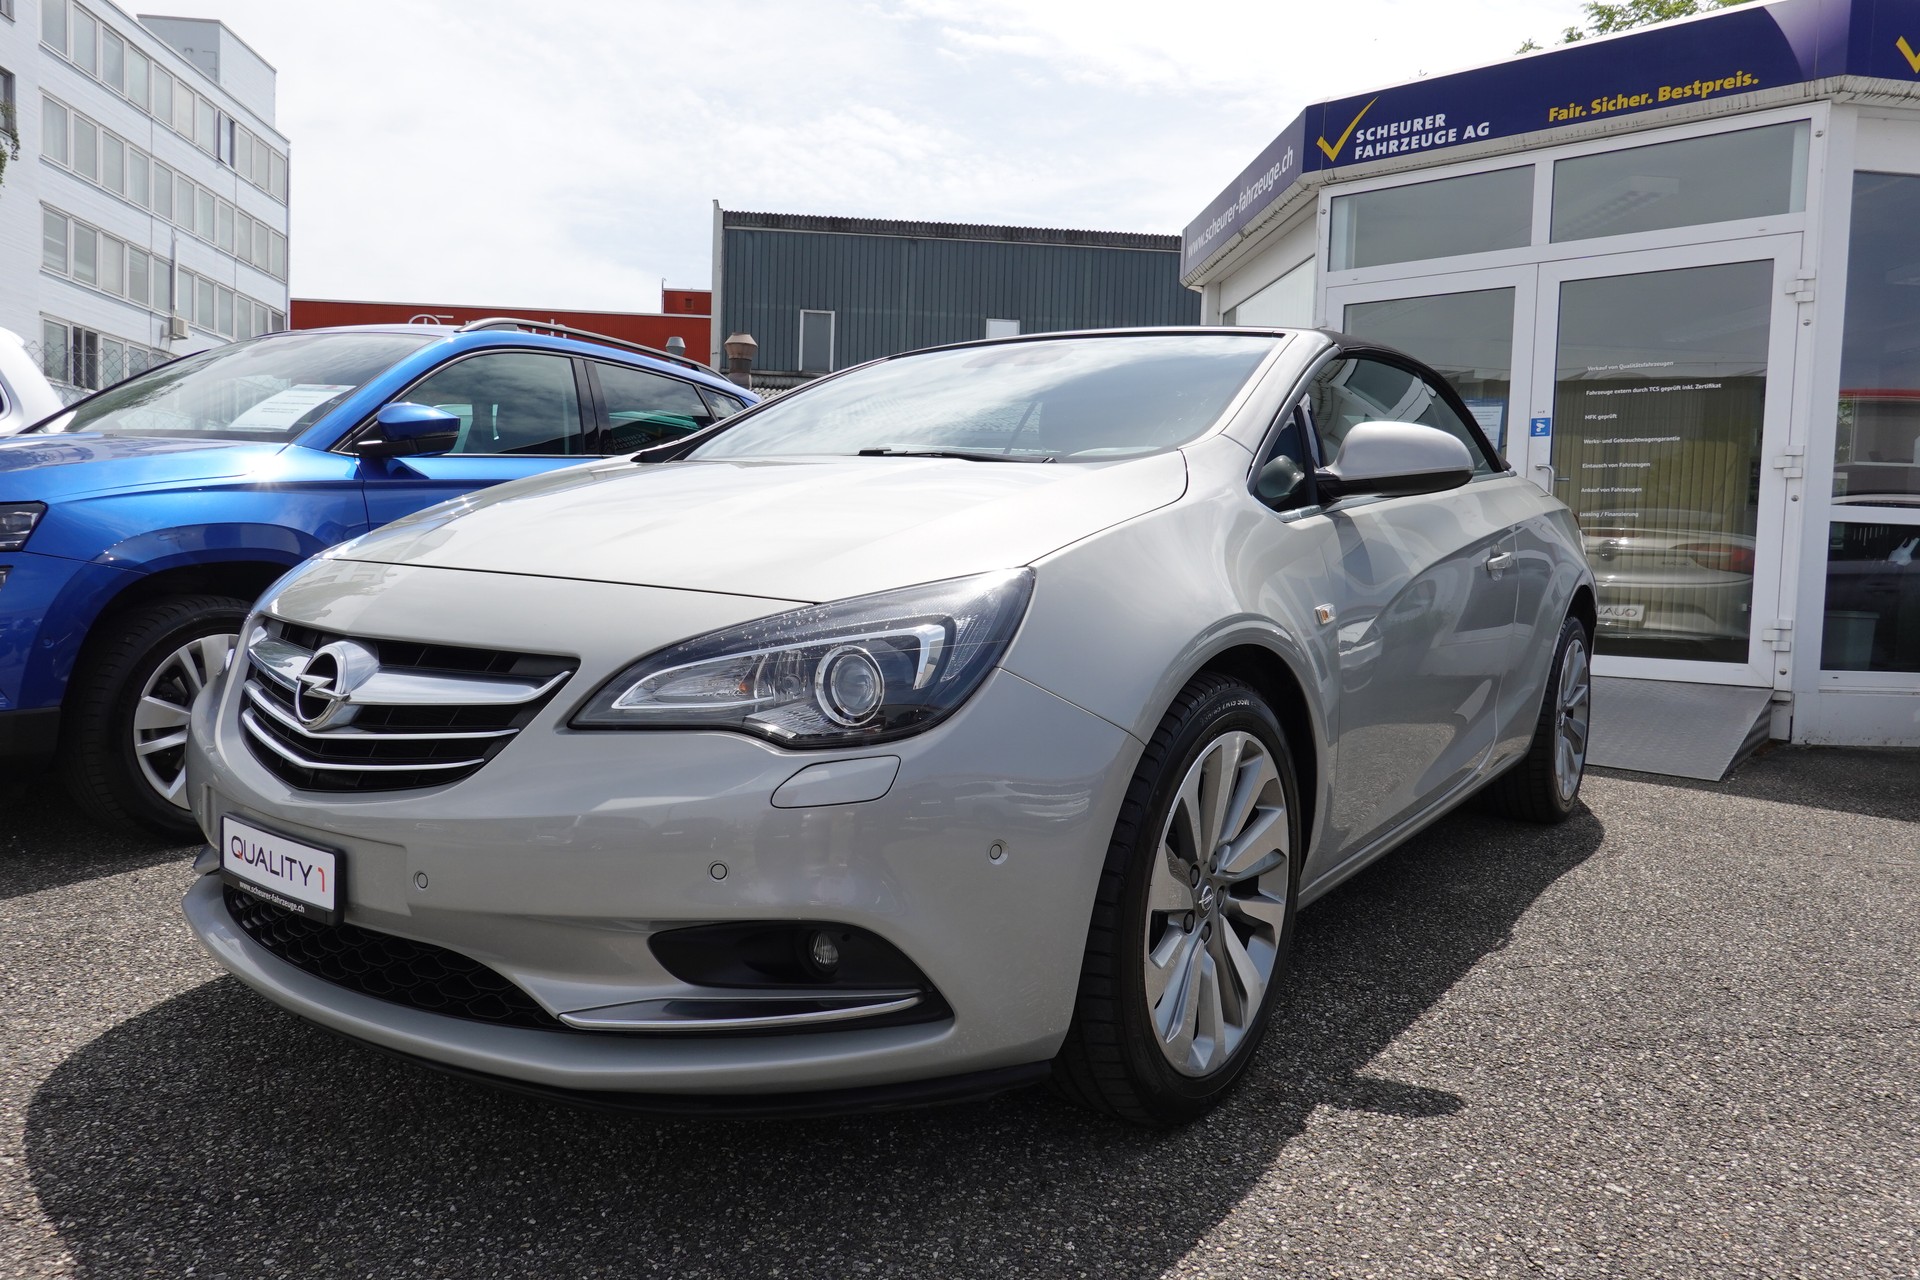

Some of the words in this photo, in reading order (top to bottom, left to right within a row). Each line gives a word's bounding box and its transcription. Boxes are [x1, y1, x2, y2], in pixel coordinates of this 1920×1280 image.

[1548, 102, 1587, 122] Fair.
[1590, 93, 1653, 115] Sicher.
[1657, 70, 1759, 102] Bestpreis.
[1354, 128, 1458, 160] FAHRZEUGE
[1462, 122, 1490, 140] AG
[1356, 113, 1446, 143] SCHEURER
[1187, 146, 1294, 258] www.scheurer-fahrzeuge.ch
[1587, 364, 1608, 372] Verkauf
[1661, 384, 1681, 392] geprüft
[1695, 382, 1722, 390] Zertifikat
[231, 835, 313, 887] QUALITY
[239, 880, 305, 914] www.scheurer-fahrzeuge.ch
